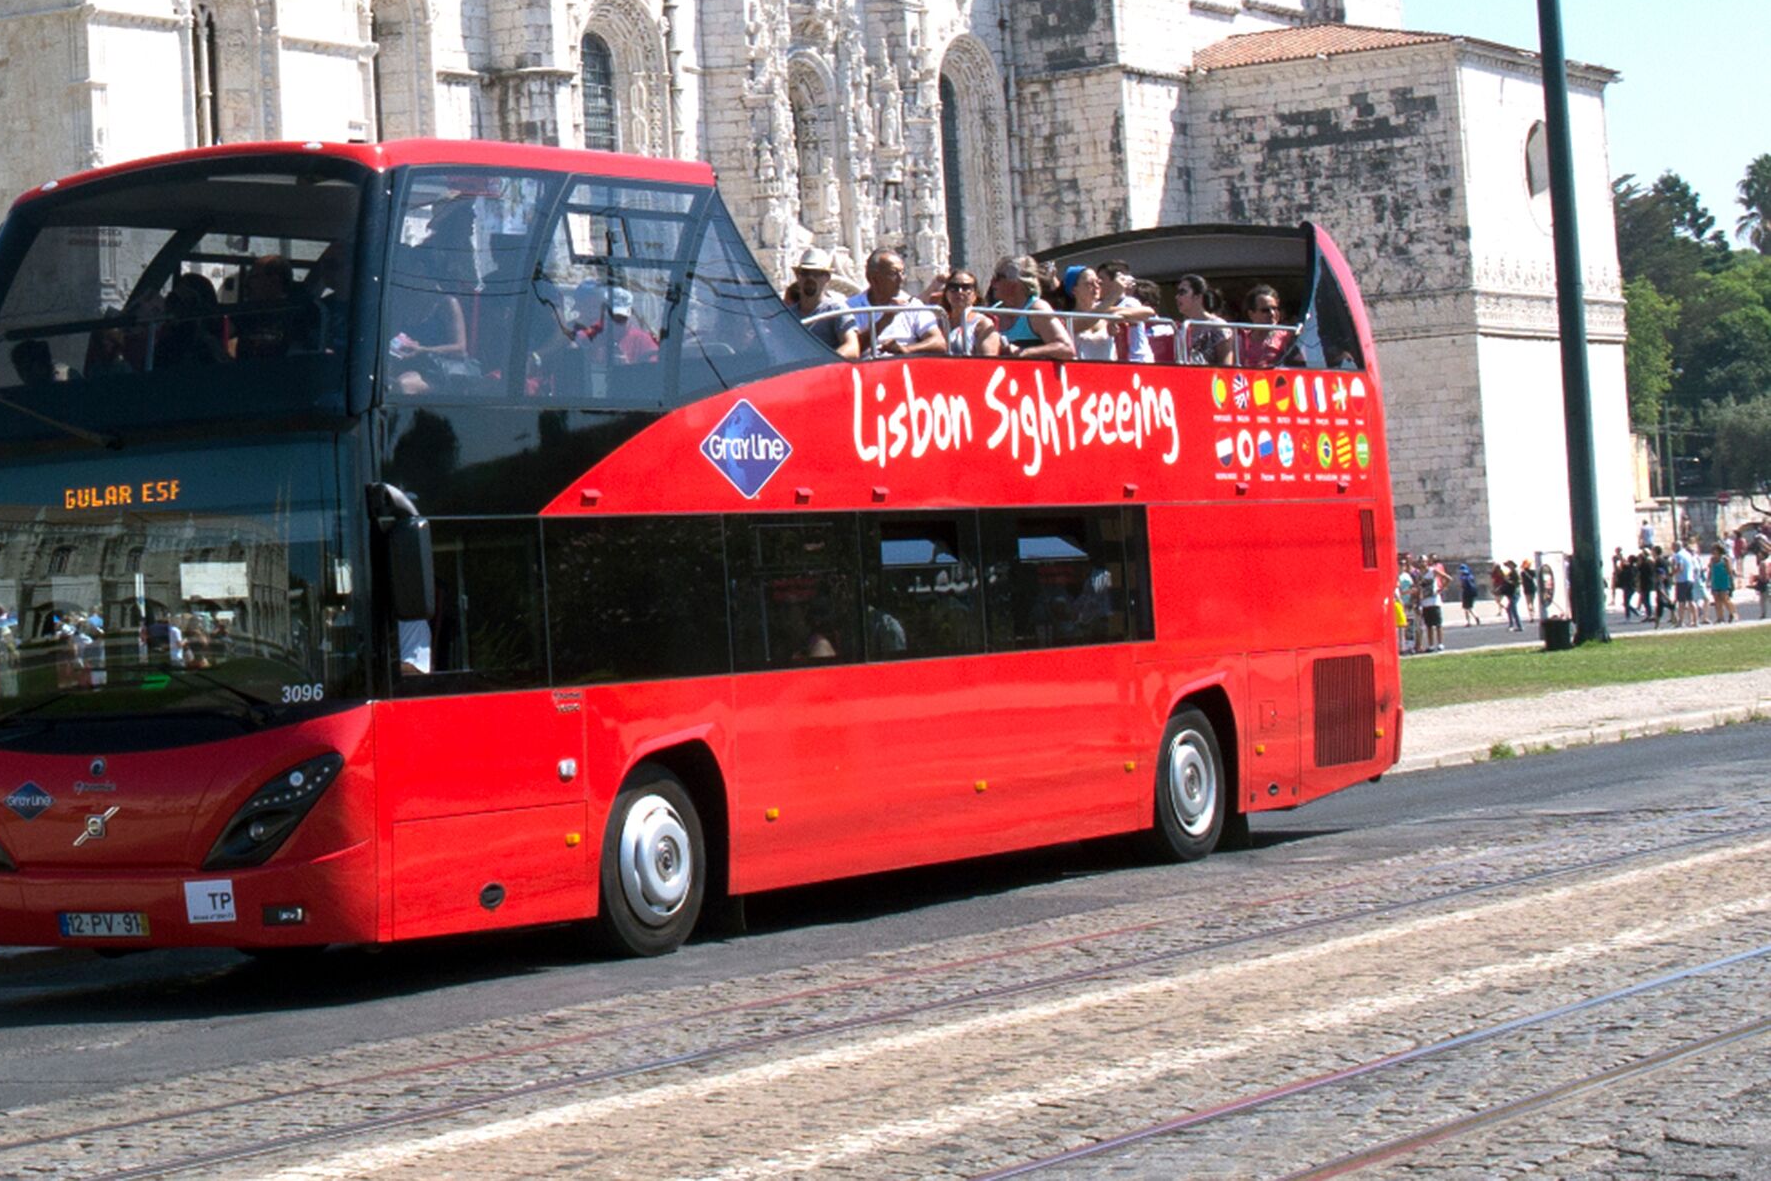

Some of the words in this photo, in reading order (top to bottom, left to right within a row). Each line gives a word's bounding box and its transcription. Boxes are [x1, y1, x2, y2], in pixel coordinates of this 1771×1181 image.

[852, 363, 972, 468] Lisbon
[985, 365, 1179, 476] Sightseeing
[282, 684, 324, 703] 3096
[208, 892, 231, 910] TP
